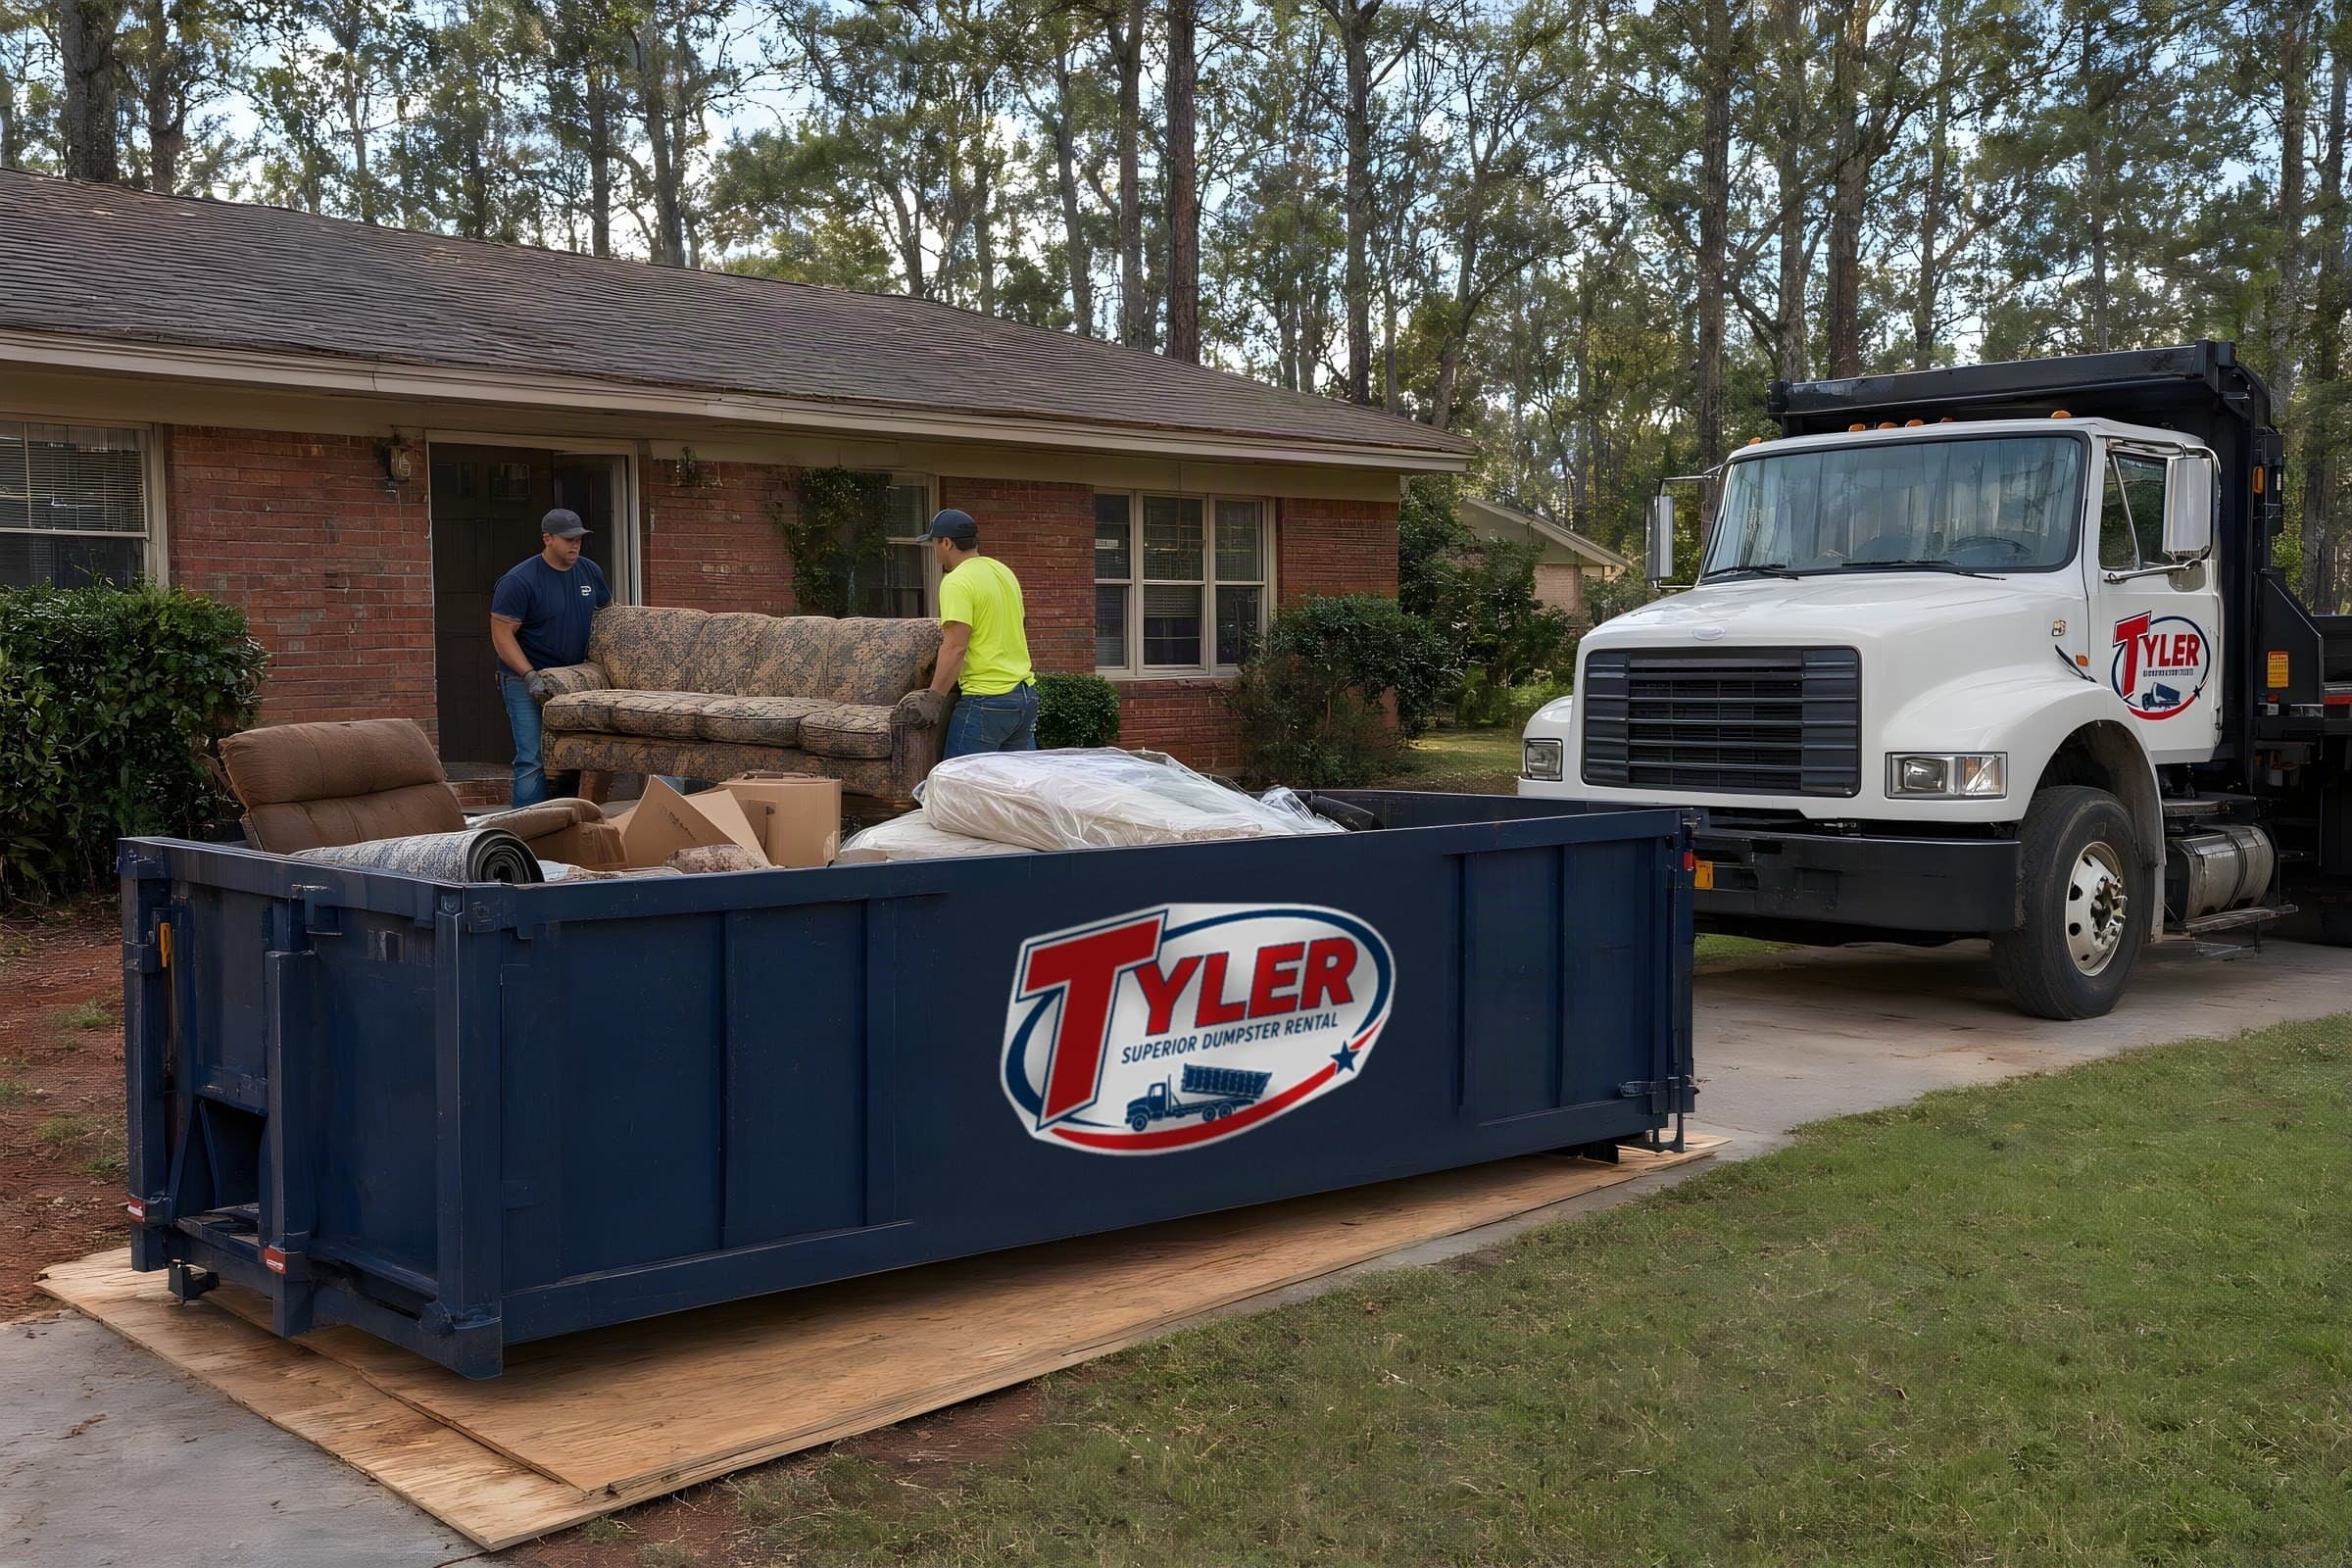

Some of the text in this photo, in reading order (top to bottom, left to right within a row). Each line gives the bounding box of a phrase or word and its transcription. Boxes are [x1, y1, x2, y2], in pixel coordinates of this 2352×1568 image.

[2114, 612, 2201, 699] TYLER
[1018, 911, 1358, 1127] TYLER
[1122, 1011, 1339, 1063] SUPERIOR DUMPSTER RENTAL
